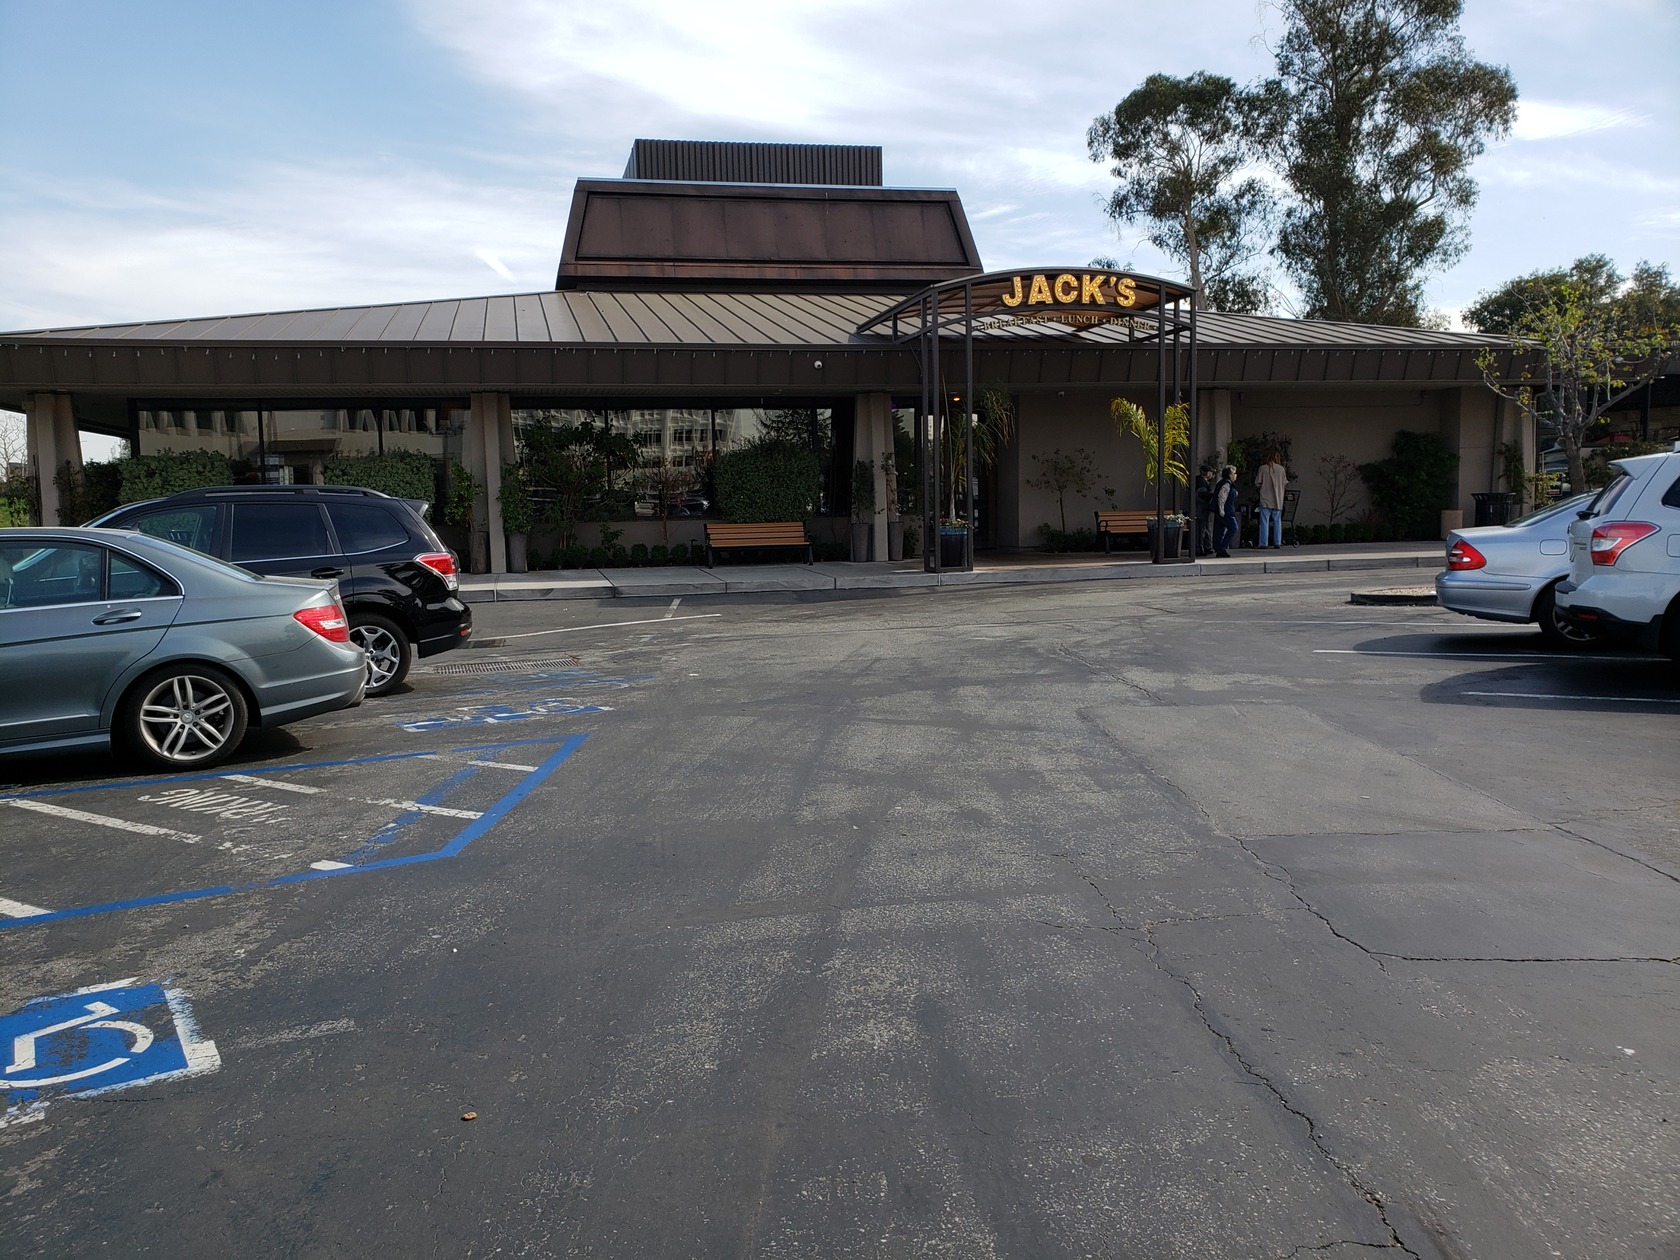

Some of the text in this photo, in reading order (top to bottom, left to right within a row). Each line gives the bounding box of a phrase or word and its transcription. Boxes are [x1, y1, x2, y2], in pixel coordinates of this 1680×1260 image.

[1002, 273, 1137, 307] JACK'S
[983, 314, 1151, 331] BREAKFAST LUNCH DINNER
